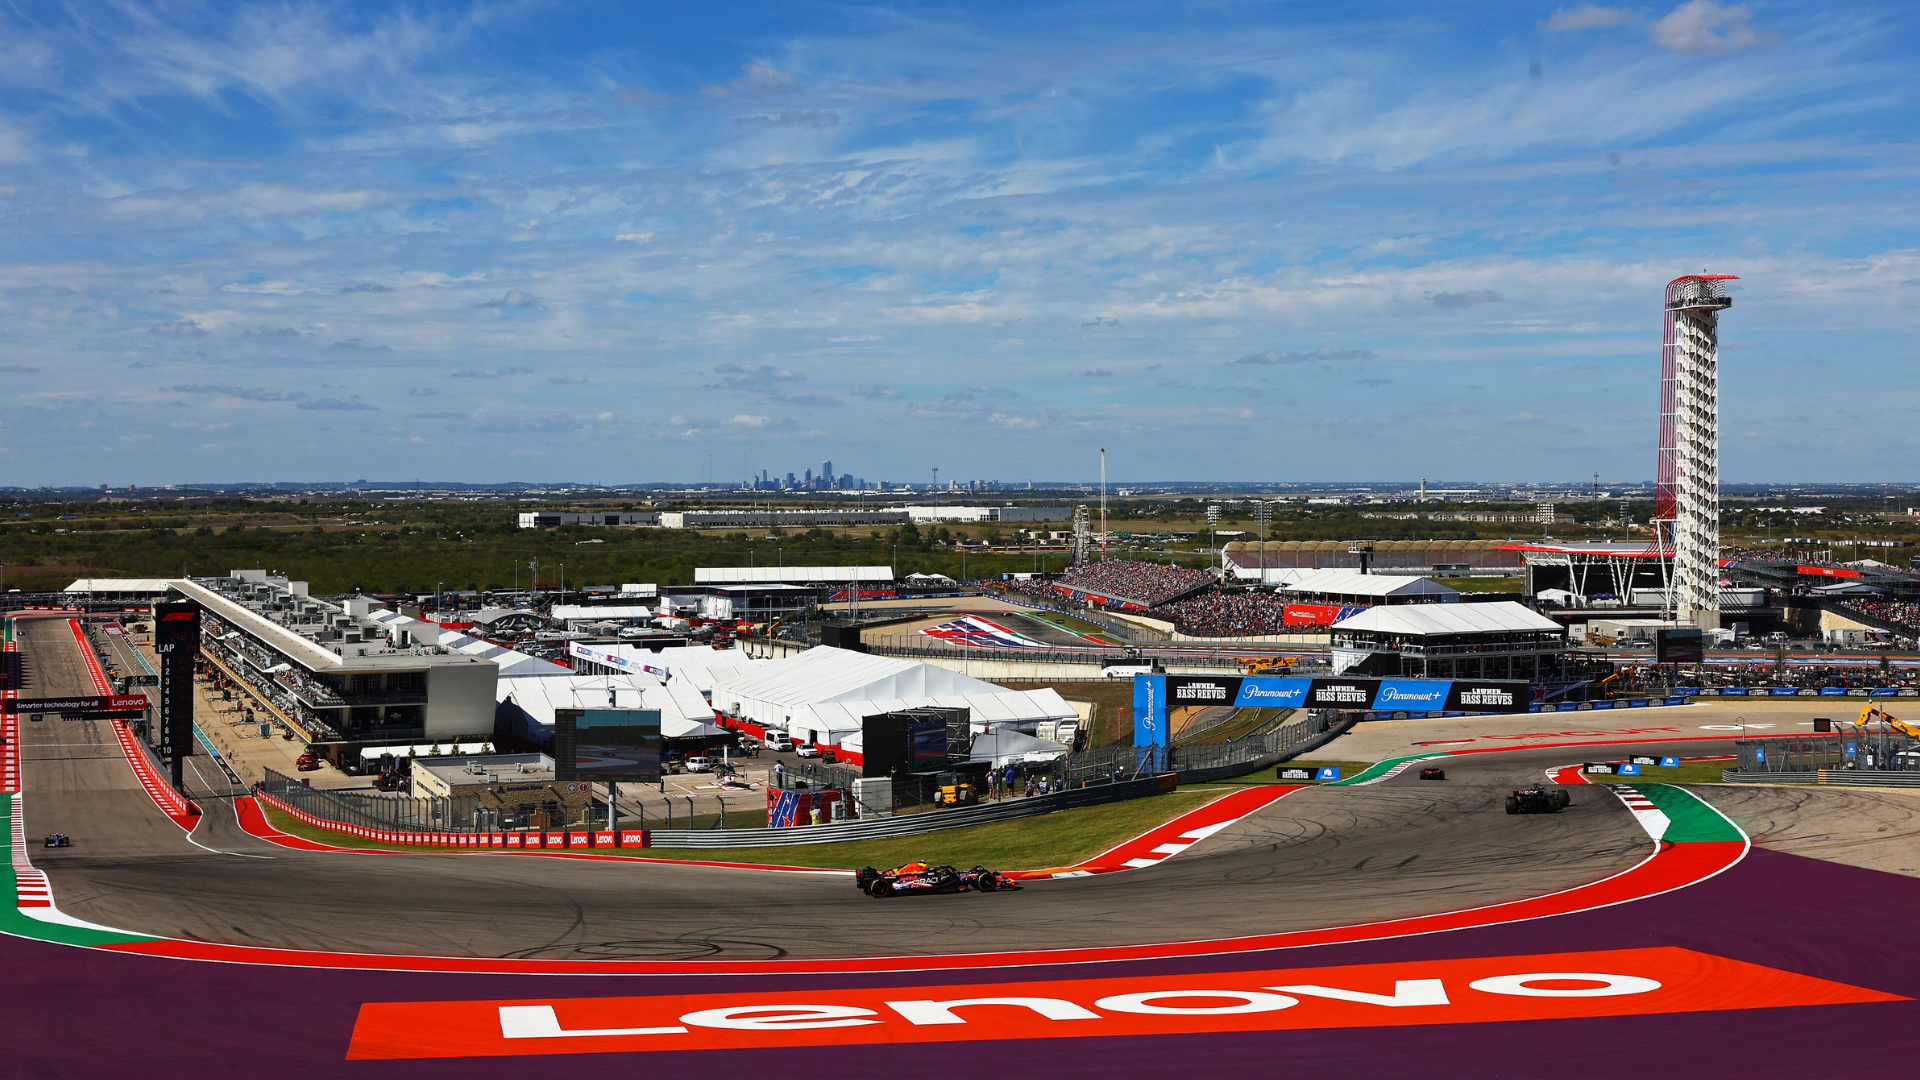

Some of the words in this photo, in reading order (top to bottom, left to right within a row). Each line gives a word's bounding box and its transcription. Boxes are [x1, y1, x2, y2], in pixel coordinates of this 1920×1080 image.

[158, 644, 175, 652] LAP
[1176, 688, 1197, 699] BASS
[1197, 688, 1226, 699] REEVES
[1243, 684, 1302, 699] Paramount+
[1316, 691, 1336, 702] BASS
[1337, 691, 1366, 702] REEVES
[1381, 687, 1441, 702] Paramount+
[1461, 694, 1481, 705] BASS
[1482, 694, 1512, 705] REEVES
[1143, 680, 1156, 731] Paramount+
[526, 835, 540, 844] Lenovo
[547, 835, 563, 844] Lenovo
[570, 834, 587, 844] Lenovo
[596, 834, 613, 844] Lenovo
[623, 833, 641, 843] Lenovo
[498, 973, 1662, 1039] Lenovo
